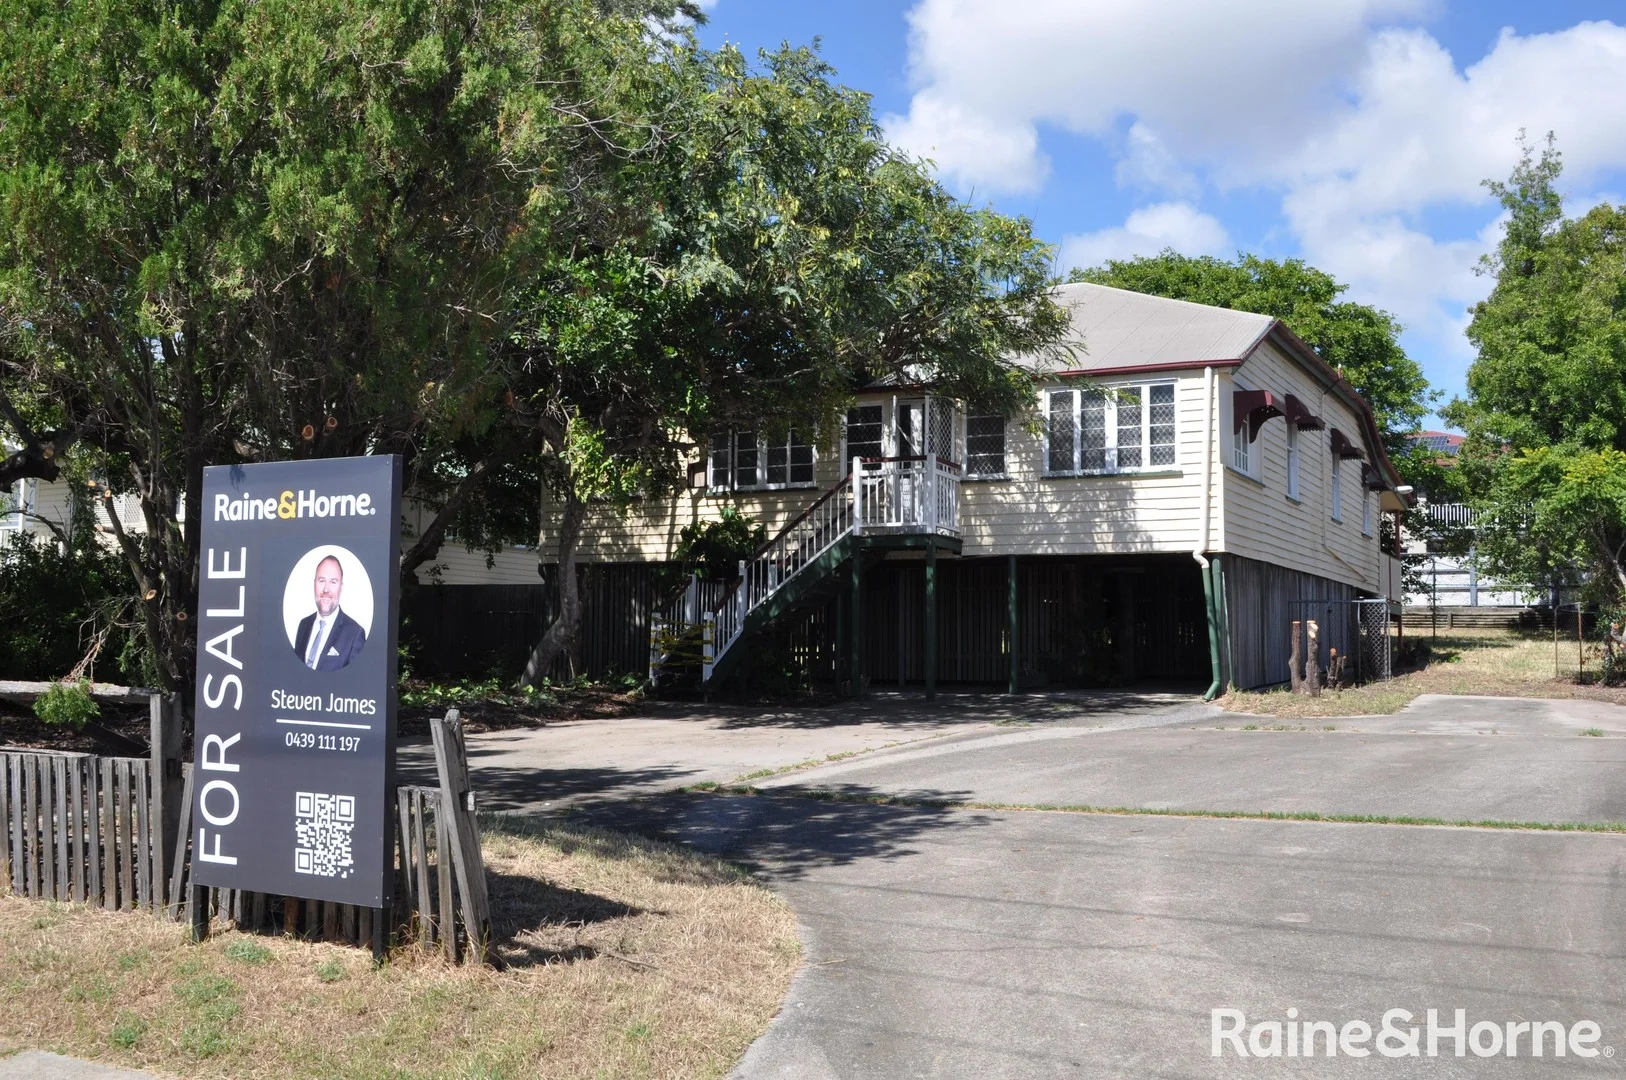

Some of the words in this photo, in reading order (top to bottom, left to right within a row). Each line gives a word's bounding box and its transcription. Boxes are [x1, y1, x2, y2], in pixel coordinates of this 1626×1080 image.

[203, 546, 247, 711] SALE
[271, 689, 322, 712] Steven
[326, 693, 376, 715] James
[285, 732, 315, 748] 0439
[318, 735, 337, 750] 111
[338, 736, 361, 752] 197
[199, 732, 241, 866] FOR
